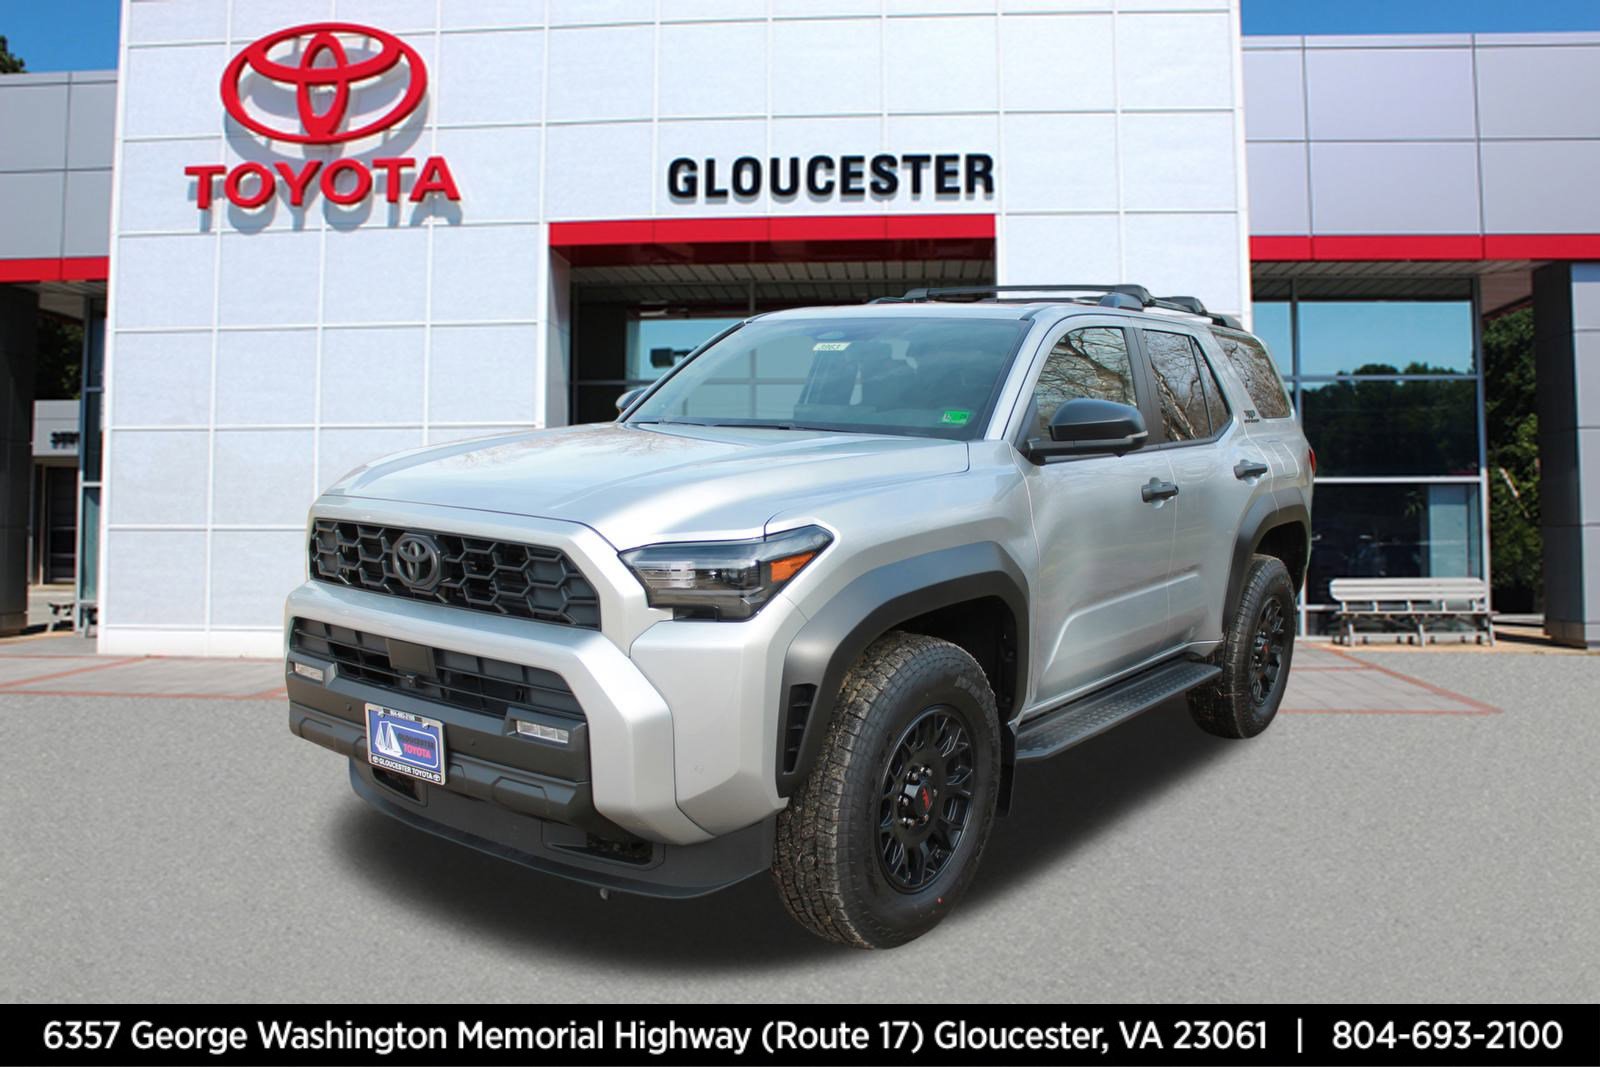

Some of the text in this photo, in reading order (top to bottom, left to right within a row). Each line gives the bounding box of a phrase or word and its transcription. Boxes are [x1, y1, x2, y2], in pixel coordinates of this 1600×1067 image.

[185, 156, 461, 210] TOYOTA
[668, 154, 994, 198] GLOUCESTER
[403, 743, 432, 759] TOYOTA
[379, 757, 433, 779] GLOUCESTER TOYOTA
